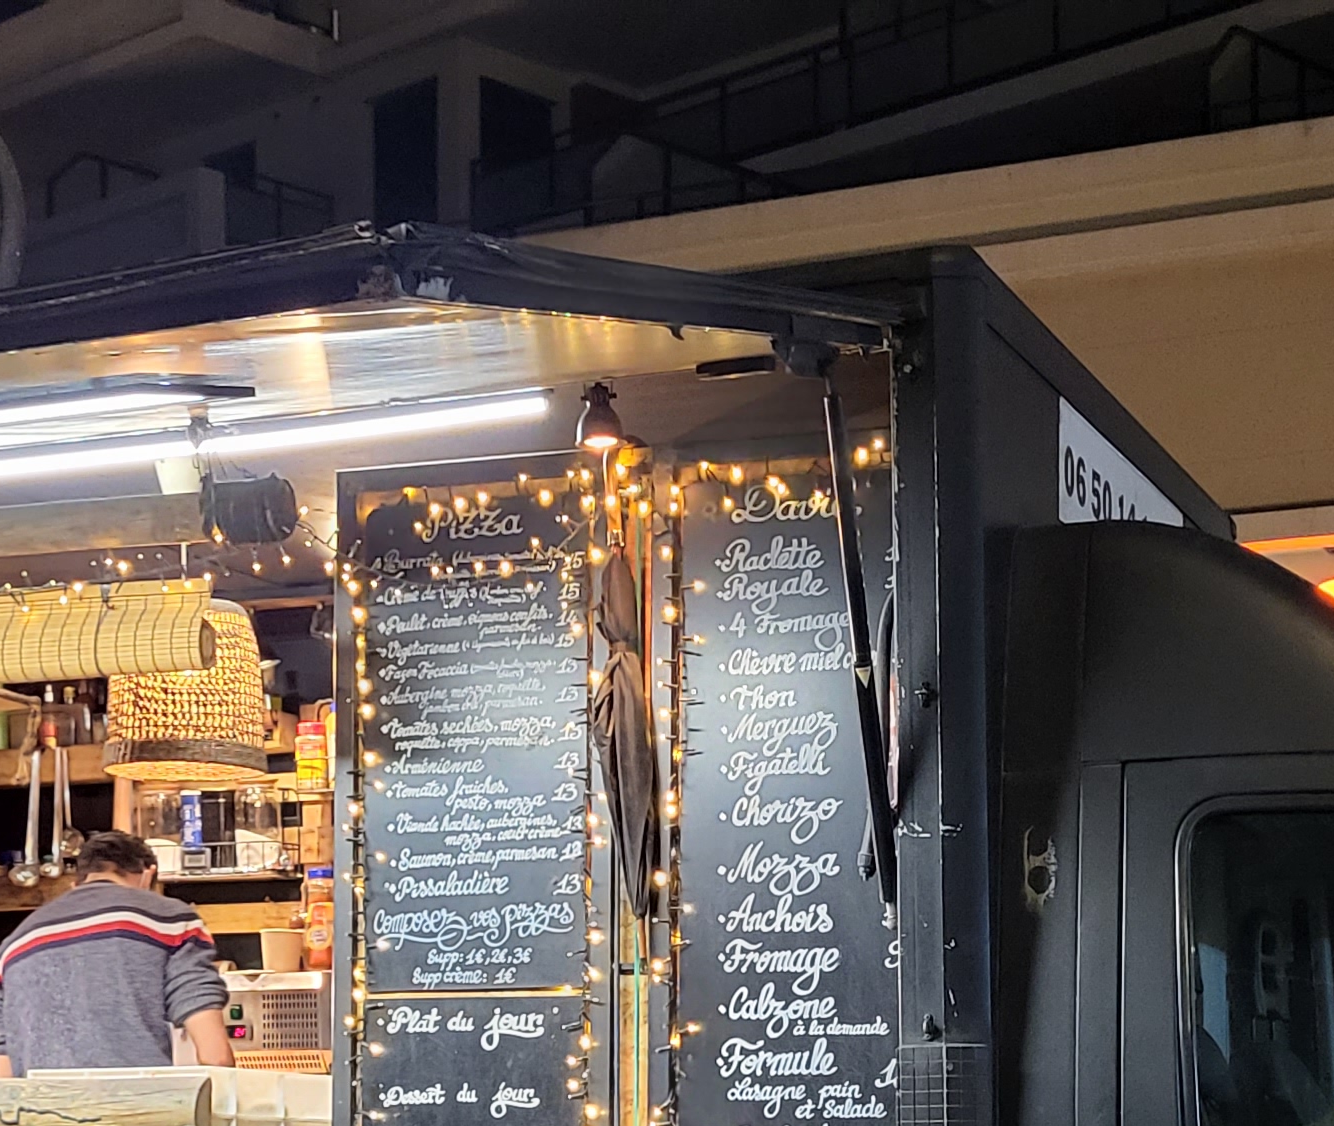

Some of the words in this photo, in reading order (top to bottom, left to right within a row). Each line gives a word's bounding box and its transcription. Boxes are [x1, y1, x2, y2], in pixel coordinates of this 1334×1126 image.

[421, 506, 524, 543] Pizza
[719, 534, 825, 573] Raclette
[720, 569, 830, 616] Royale
[729, 612, 747, 639] 4
[729, 684, 797, 711] Thon
[727, 710, 839, 757] Merguez
[727, 743, 832, 796] Figatelli
[493, 793, 547, 815] mozza
[550, 783, 579, 802] 13
[731, 795, 844, 845] Chorizo
[553, 873, 582, 896] 13
[726, 840, 841, 896] Mozza
[725, 892, 835, 934] Anchois
[723, 938, 840, 996] Fromage
[385, 1005, 443, 1034] Plat
[447, 1010, 475, 1032] du
[480, 1007, 545, 1051] jour
[728, 982, 838, 1039] Calzone
[792, 1019, 806, 1036] à
[808, 1019, 825, 1036] la
[825, 1015, 890, 1036] demande
[719, 1037, 839, 1078] Formule
[383, 1084, 446, 1108] Dessert
[456, 1083, 478, 1103] du
[489, 1082, 541, 1118] jour
[727, 1076, 807, 1118] Lasagne
[817, 1080, 862, 1109] pain
[795, 1101, 816, 1119] et
